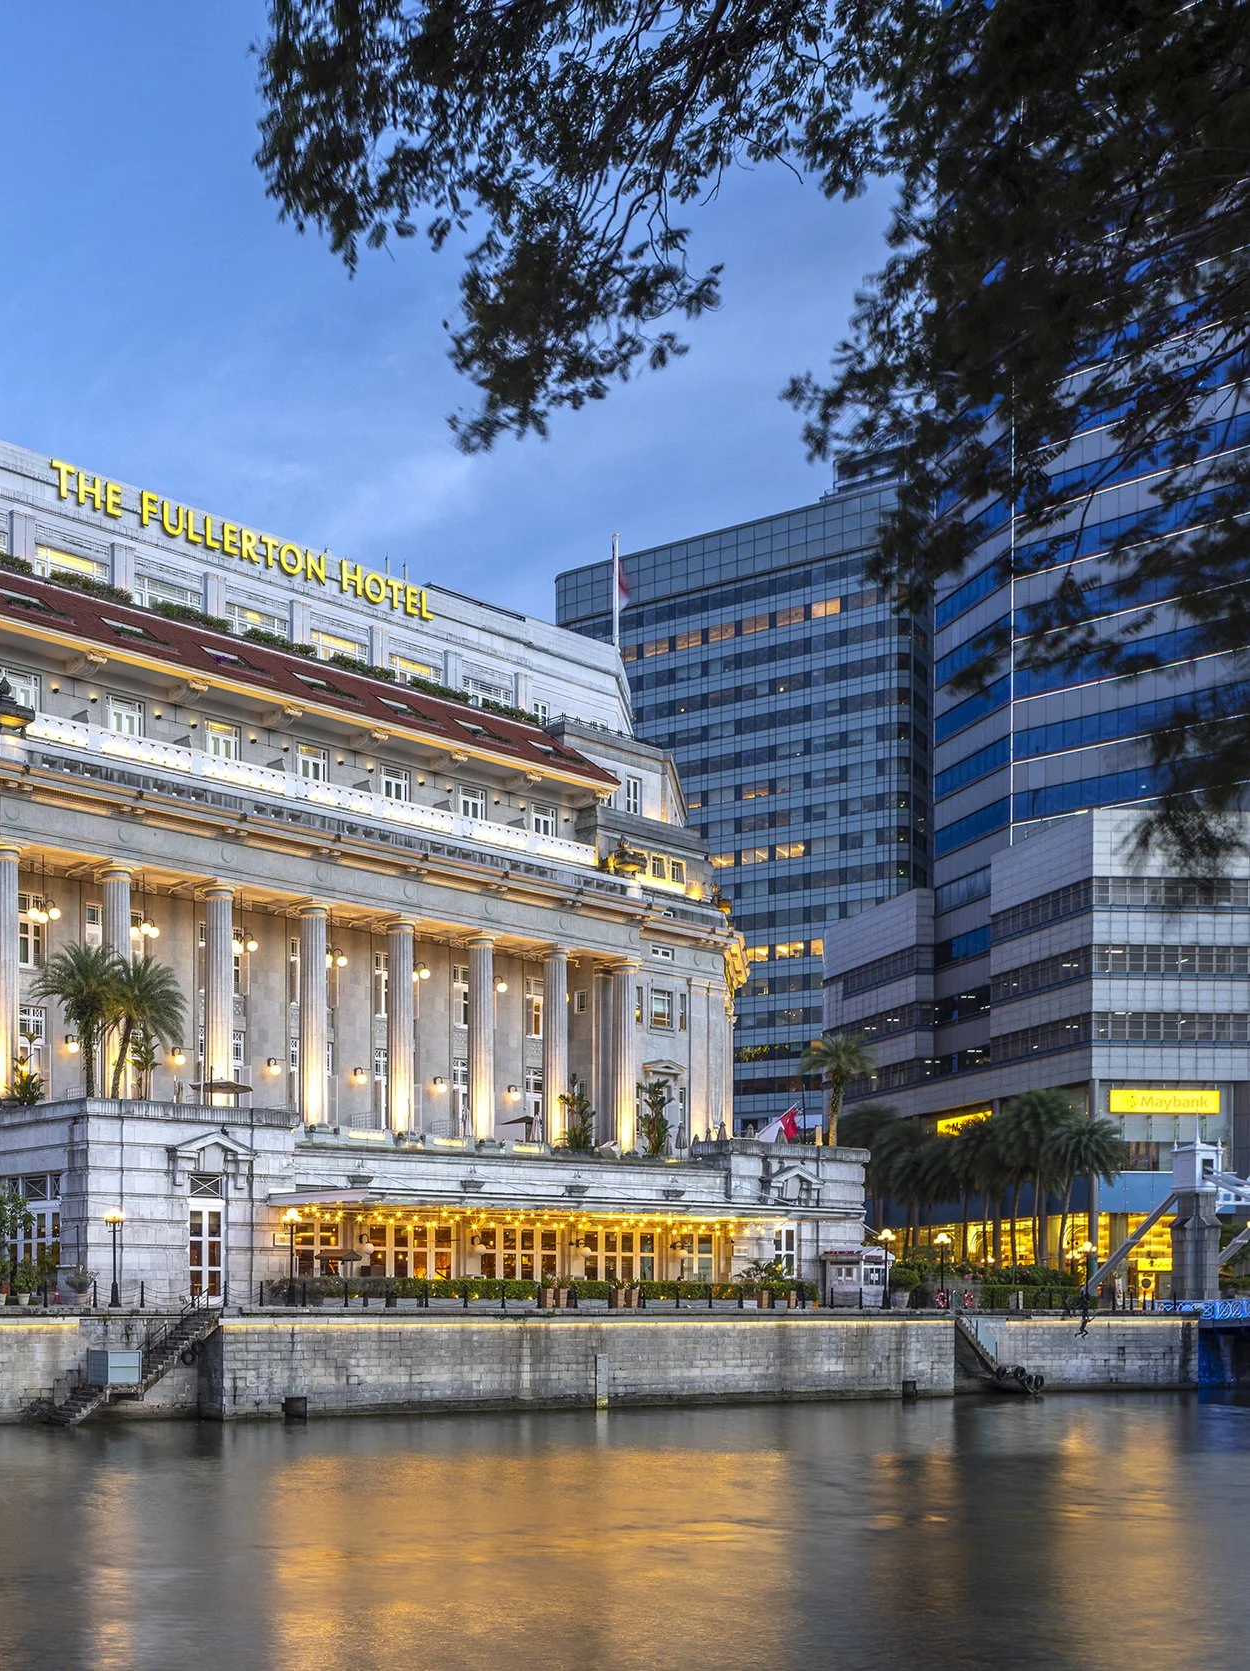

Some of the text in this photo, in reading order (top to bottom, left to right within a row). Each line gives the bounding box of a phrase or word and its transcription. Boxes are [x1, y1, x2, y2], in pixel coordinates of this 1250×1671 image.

[51, 458, 434, 621] THE FULLERTON HOTEL
[1140, 1096, 1209, 1110] Maybank
